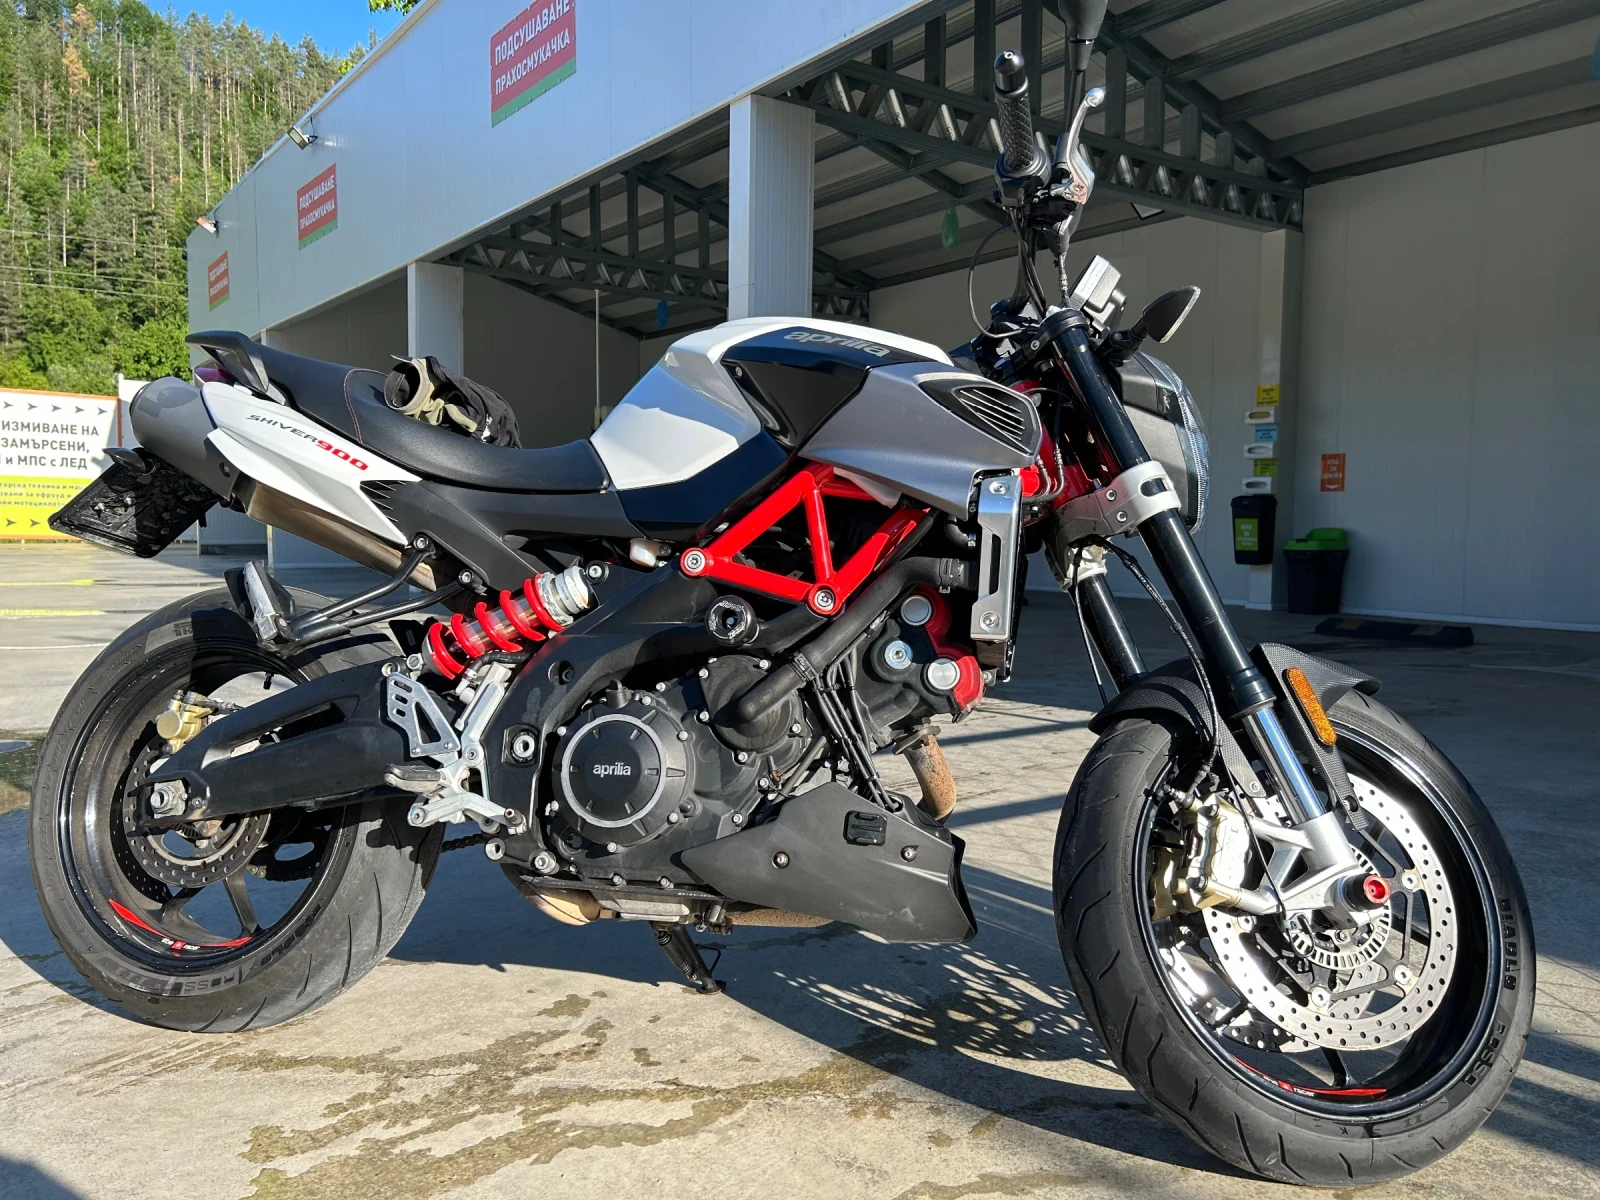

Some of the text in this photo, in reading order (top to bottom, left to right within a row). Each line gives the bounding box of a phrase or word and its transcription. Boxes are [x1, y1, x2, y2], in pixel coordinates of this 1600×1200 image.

[495, 0, 570, 66] ПОДСУШАВАНЕ
[495, 28, 571, 96] ПРАХОСМУКАЧКА
[783, 331, 891, 358] aprilia
[1, 420, 99, 436] ИЗМИВАНЕ НА
[1, 437, 90, 454] ЗАМЪРСЕНИ,
[5, 454, 88, 470] и МПС с ЛЕД
[592, 762, 631, 778] aprilia
[1500, 897, 1519, 991] DIABLO
